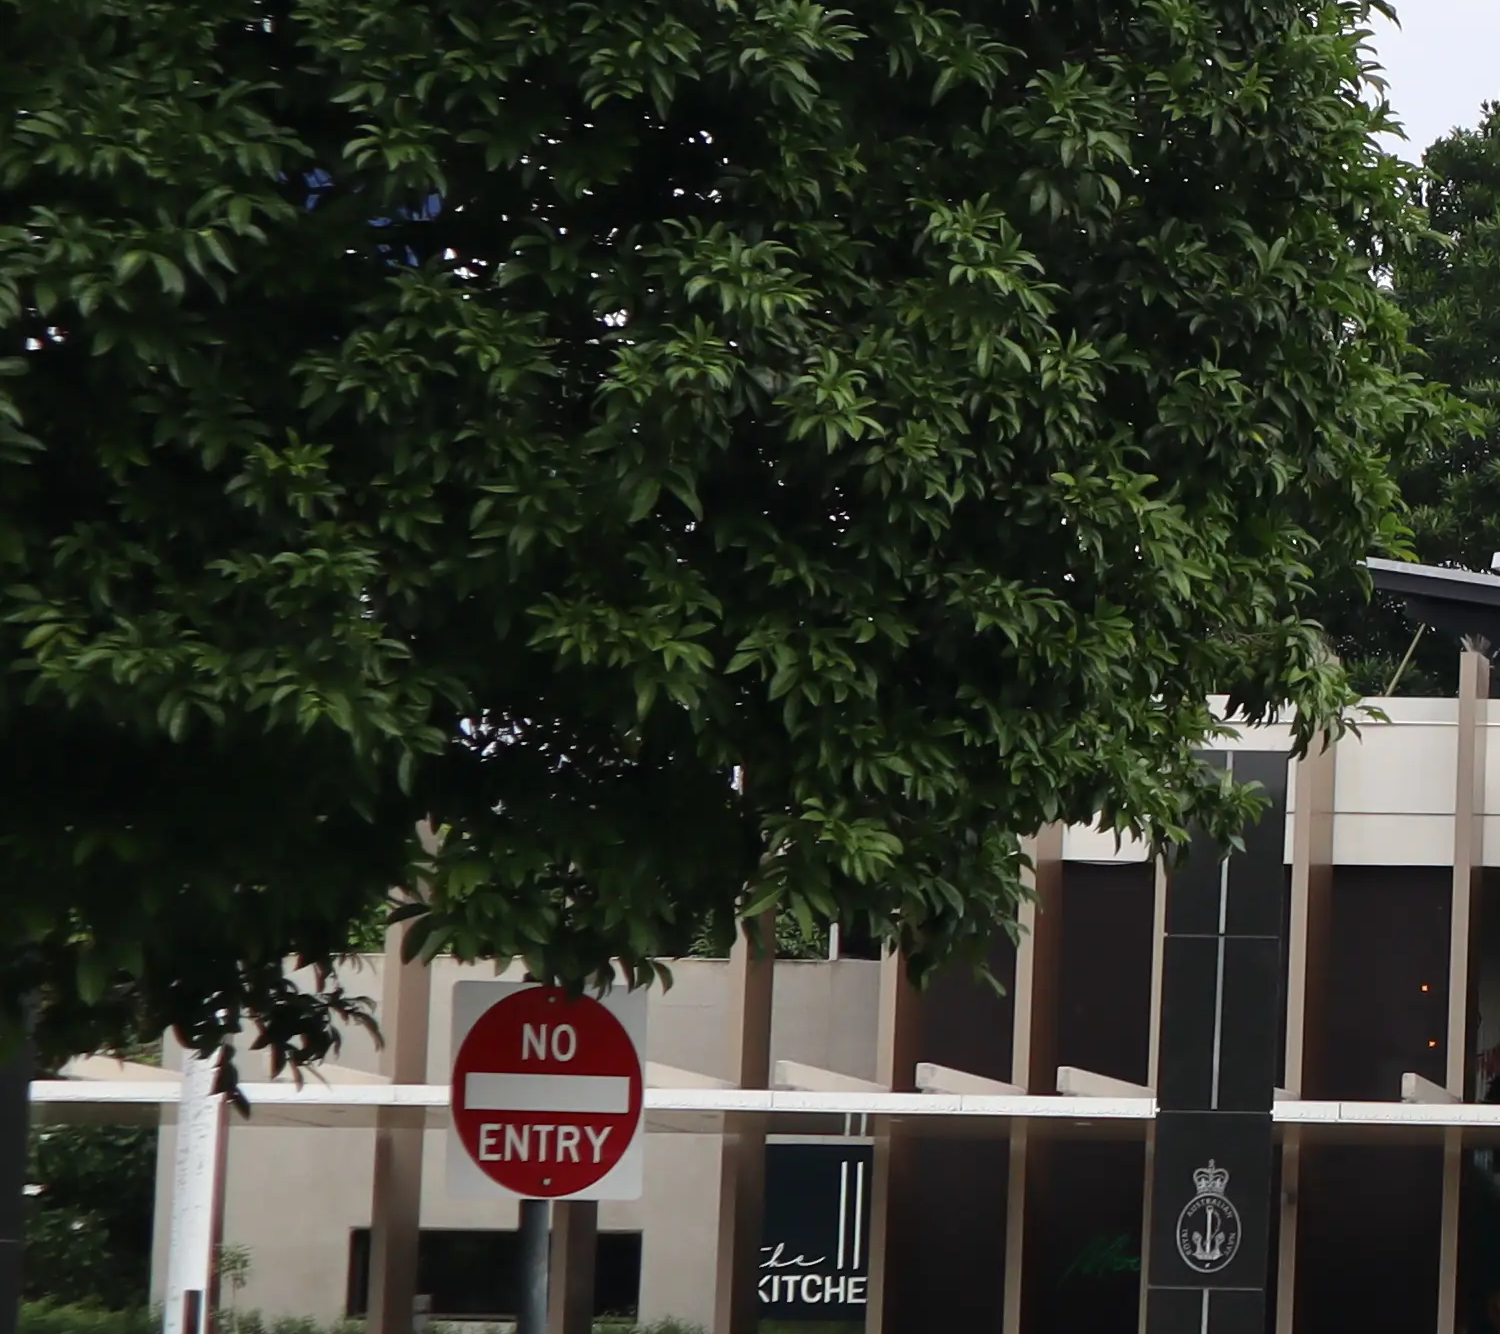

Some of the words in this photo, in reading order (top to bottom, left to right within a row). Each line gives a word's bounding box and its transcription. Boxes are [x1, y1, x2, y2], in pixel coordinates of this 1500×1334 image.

[521, 1023, 577, 1062] NO
[478, 1123, 613, 1164] ENTRY
[757, 1273, 869, 1305] KITCHE
